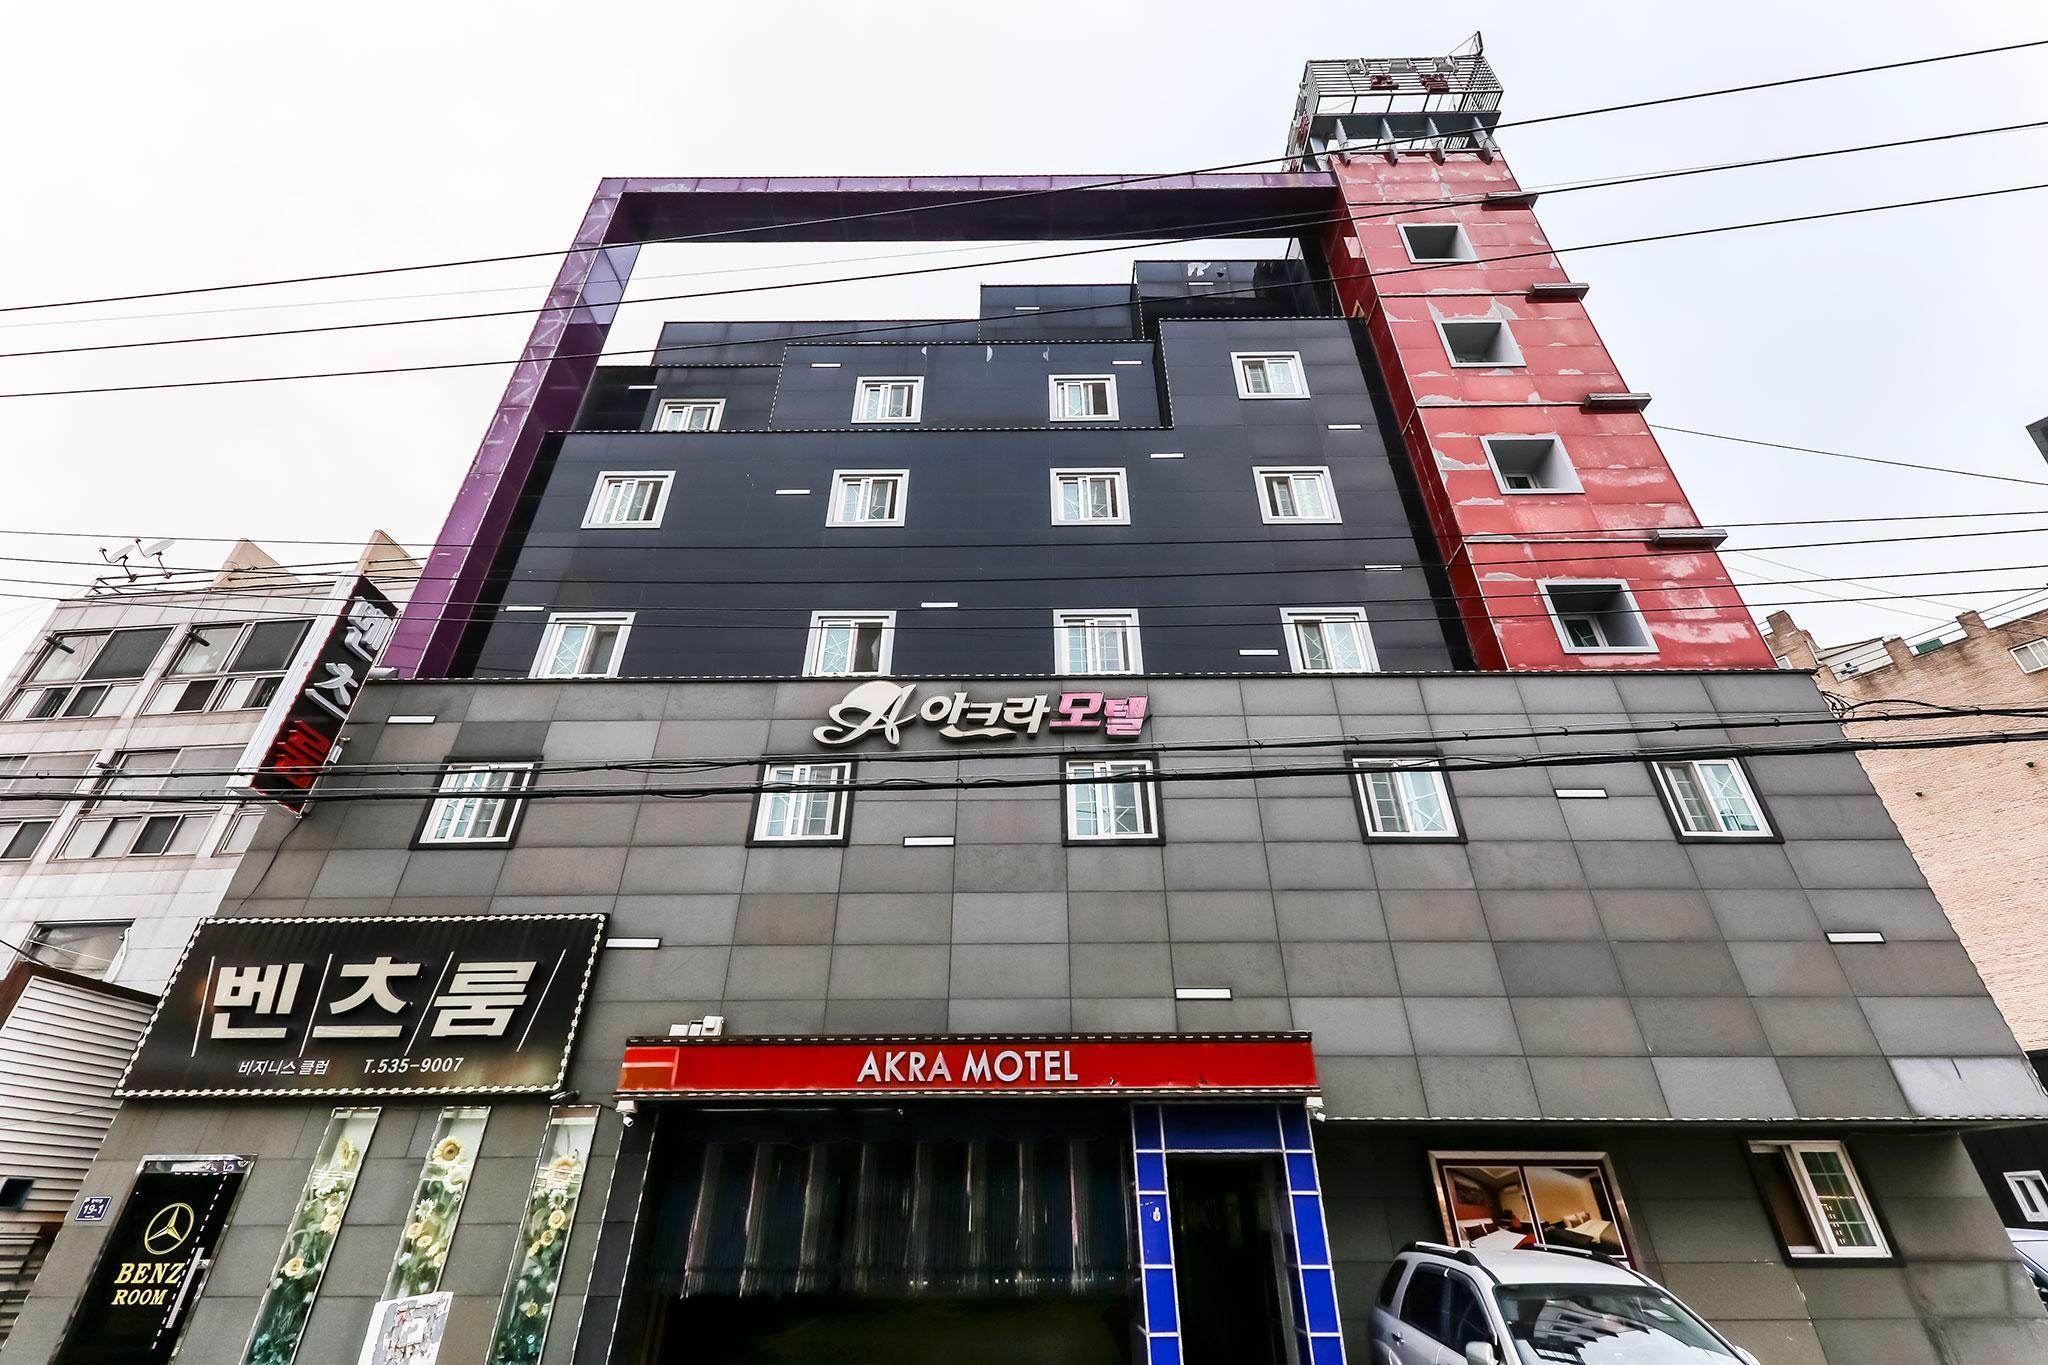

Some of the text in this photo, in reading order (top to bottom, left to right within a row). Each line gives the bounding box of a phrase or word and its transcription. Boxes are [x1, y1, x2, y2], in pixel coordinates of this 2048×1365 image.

[211, 957, 537, 1039] 벤츠룸
[238, 1057, 464, 1076] 비지니스 클럽 T.535-9007
[856, 1049, 1079, 1083] AKRA MOTEL
[83, 1203, 104, 1215] 19-1
[114, 1262, 185, 1284] BENZ
[111, 1289, 168, 1305] ROOM
